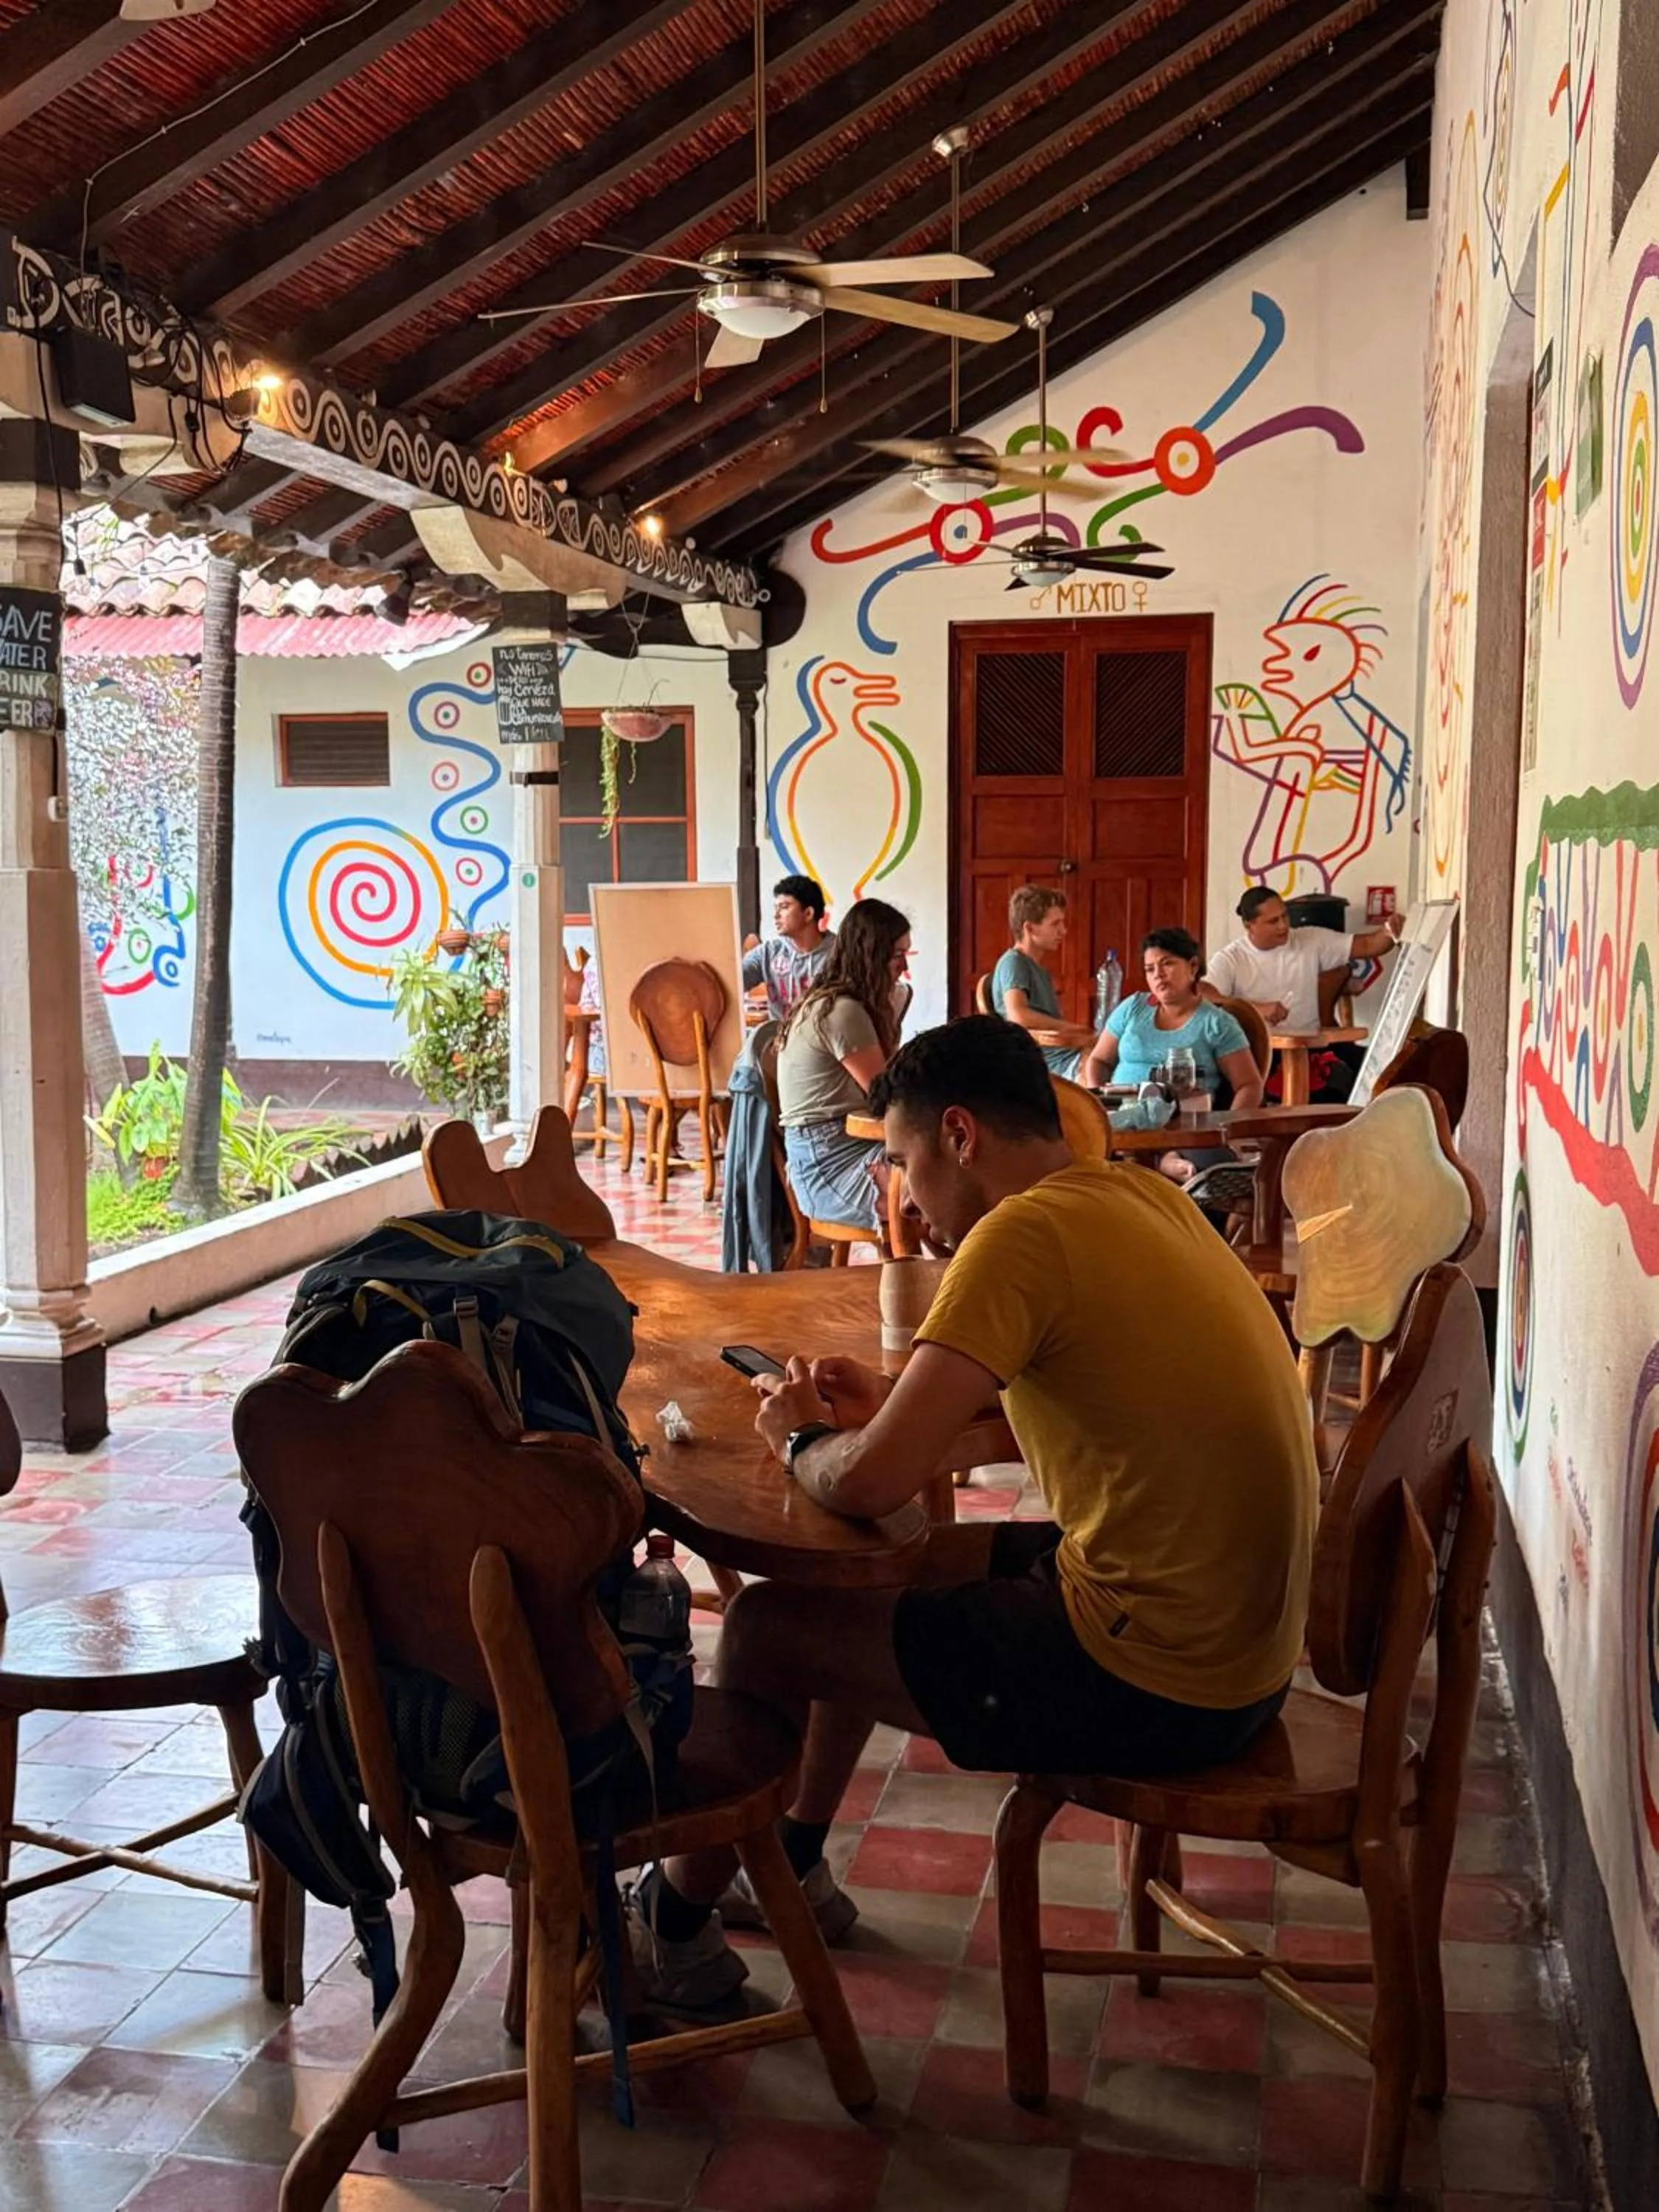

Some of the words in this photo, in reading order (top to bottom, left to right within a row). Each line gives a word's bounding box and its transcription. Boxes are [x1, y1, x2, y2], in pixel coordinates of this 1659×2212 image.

[1057, 582, 1125, 613] MIXTO
[0, 604, 52, 643] AVE
[0, 638, 46, 670] ATER
[0, 669, 48, 698] RINK
[0, 697, 32, 728] EER
